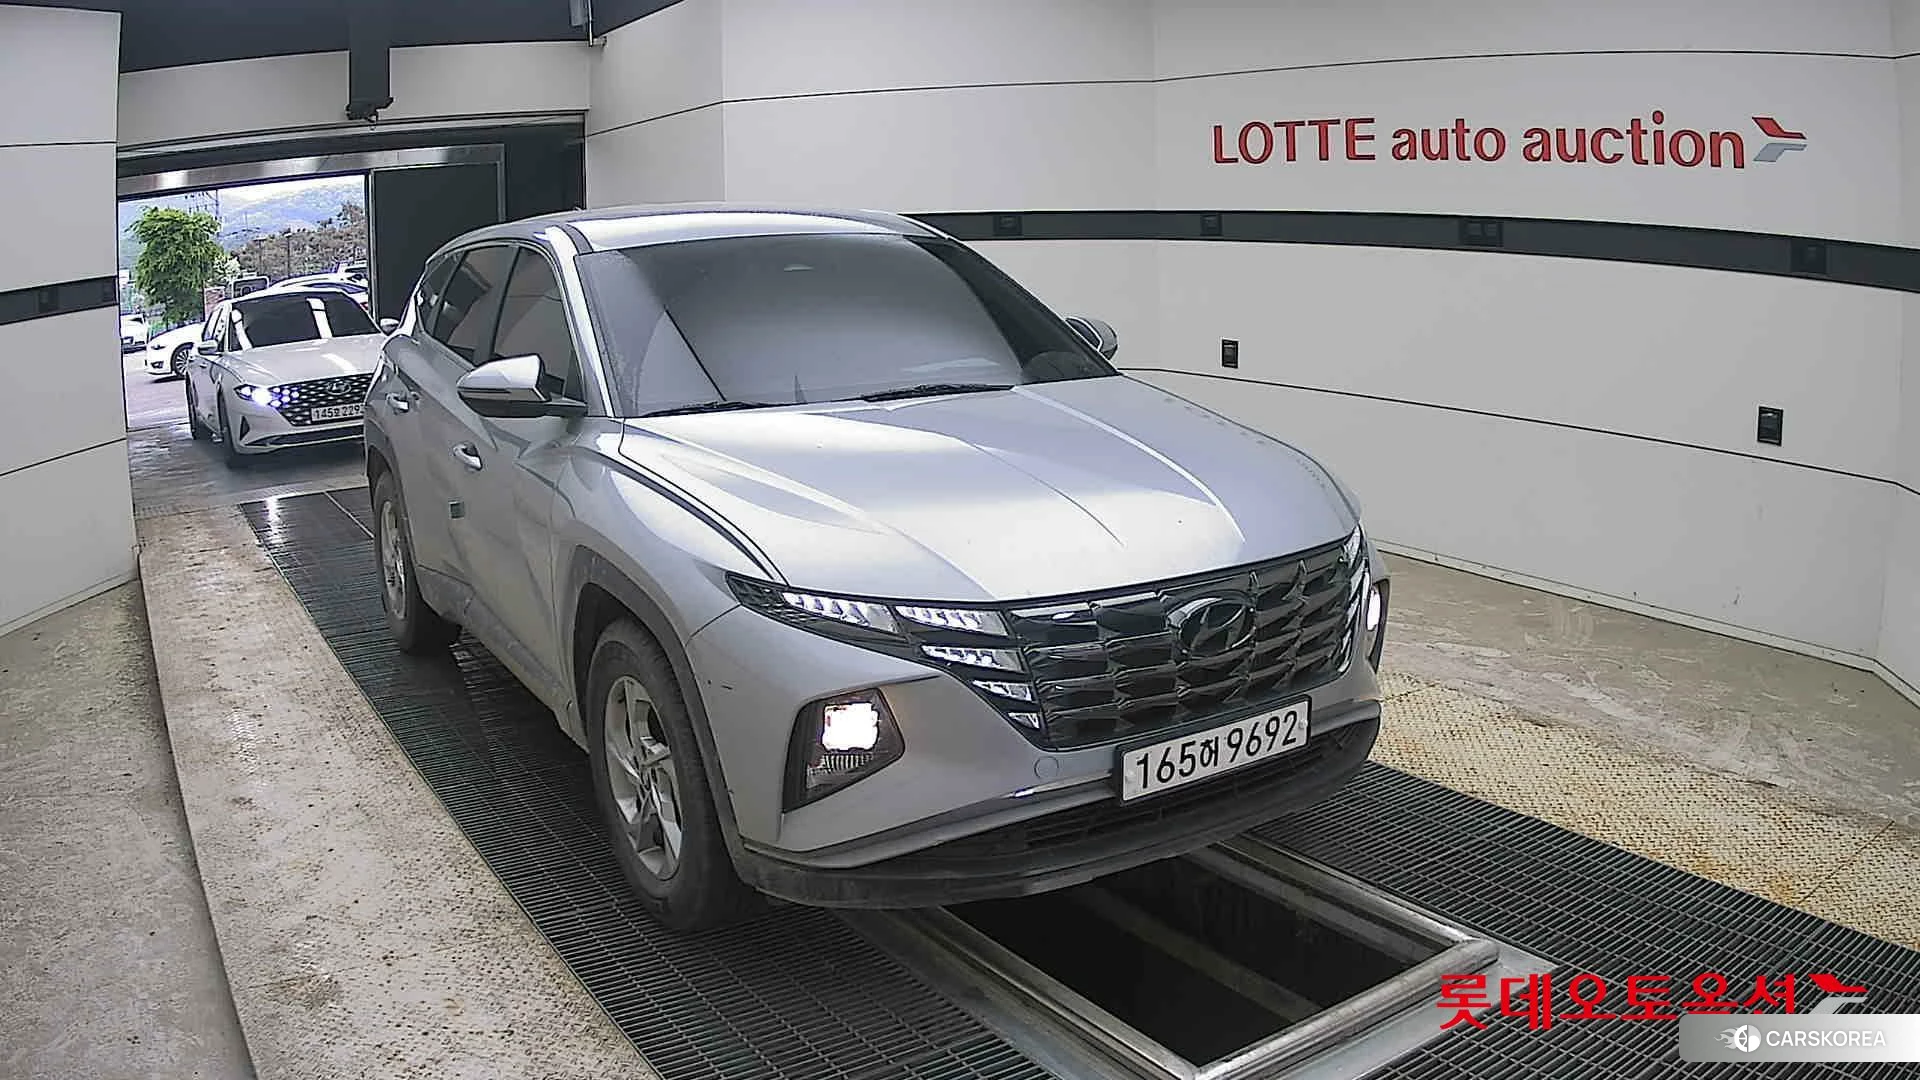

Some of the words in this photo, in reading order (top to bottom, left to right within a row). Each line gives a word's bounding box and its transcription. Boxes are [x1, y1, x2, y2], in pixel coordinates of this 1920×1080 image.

[1213, 118, 1376, 164] LOTTE
[1391, 118, 1506, 162] auto
[1521, 110, 1746, 169] auction
[1136, 736, 1219, 789] 165허
[1226, 710, 1298, 763] 9692
